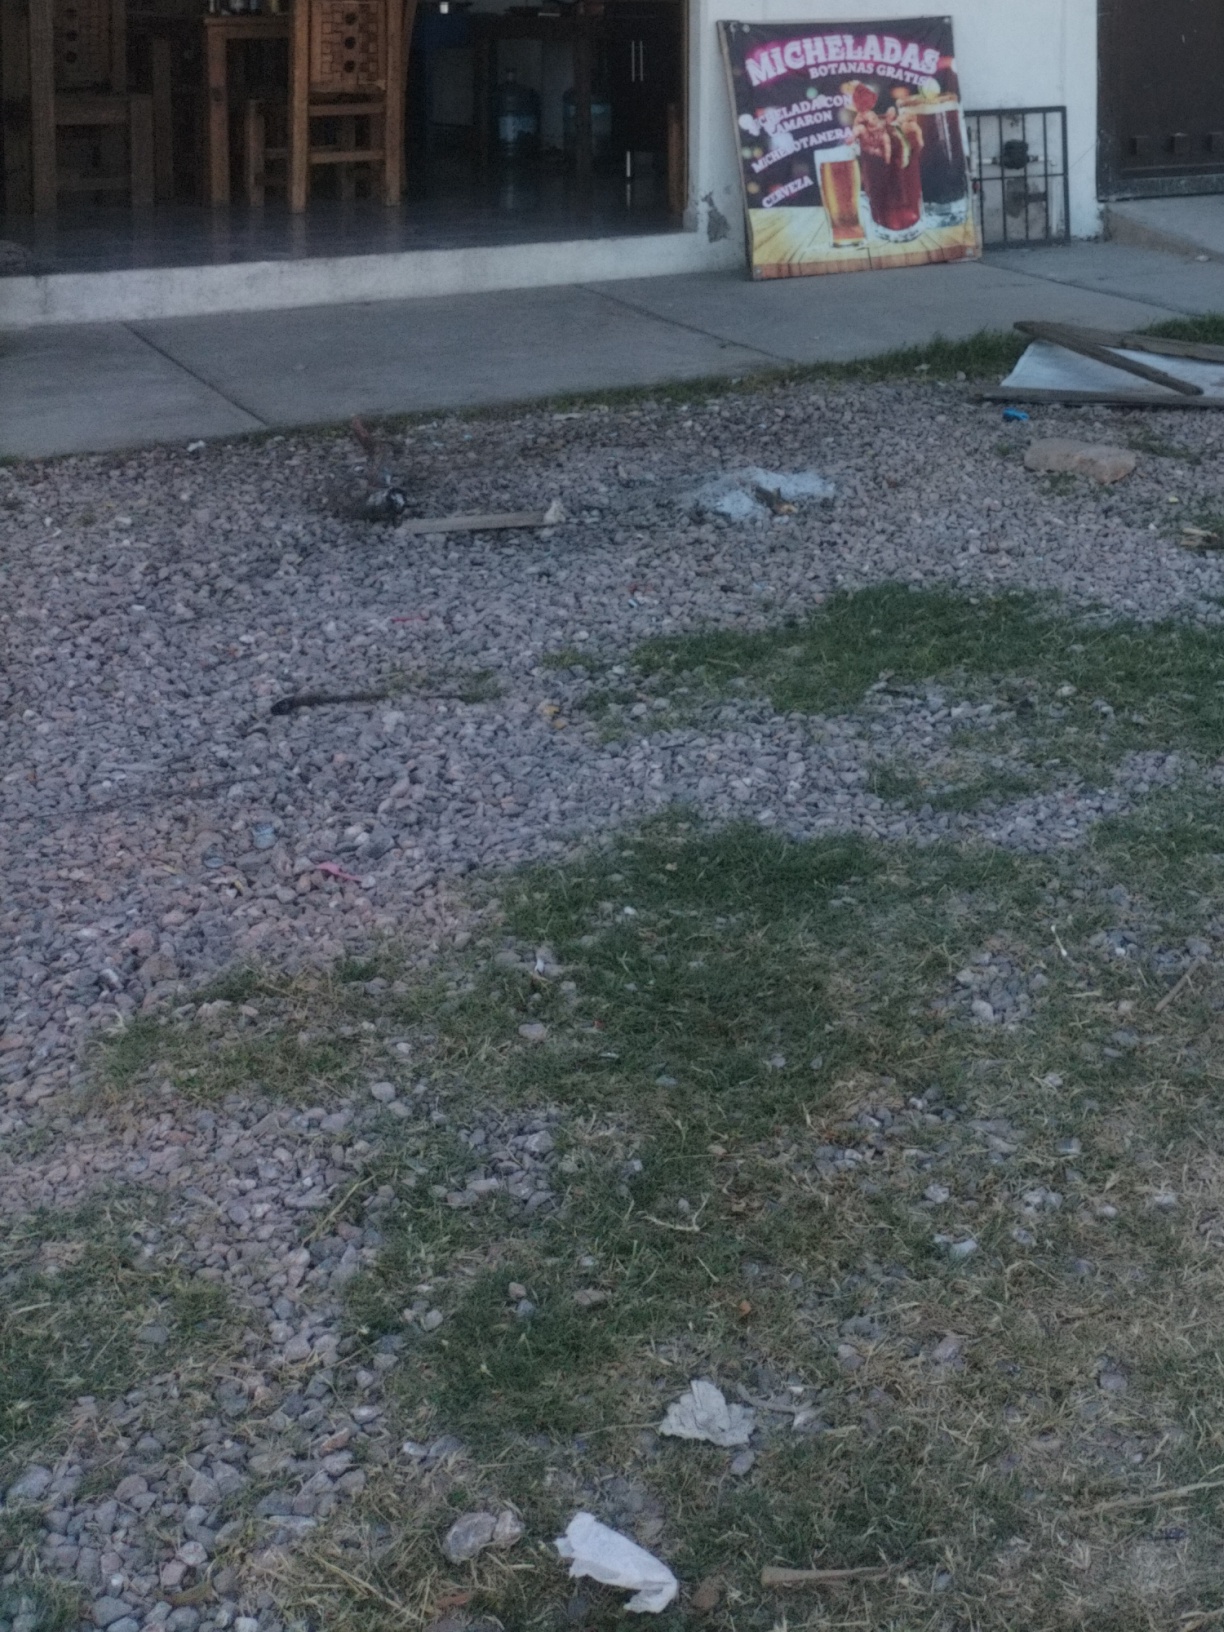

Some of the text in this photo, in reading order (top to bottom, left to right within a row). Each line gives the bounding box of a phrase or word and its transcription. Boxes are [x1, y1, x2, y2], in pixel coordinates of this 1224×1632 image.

[745, 34, 940, 87] MICHELADAS
[809, 61, 930, 86] BOTANAS GRATIS
[747, 98, 823, 135] CELADA
[751, 126, 853, 174] MICHEOTANERA
[762, 175, 814, 208] CERVEZA
